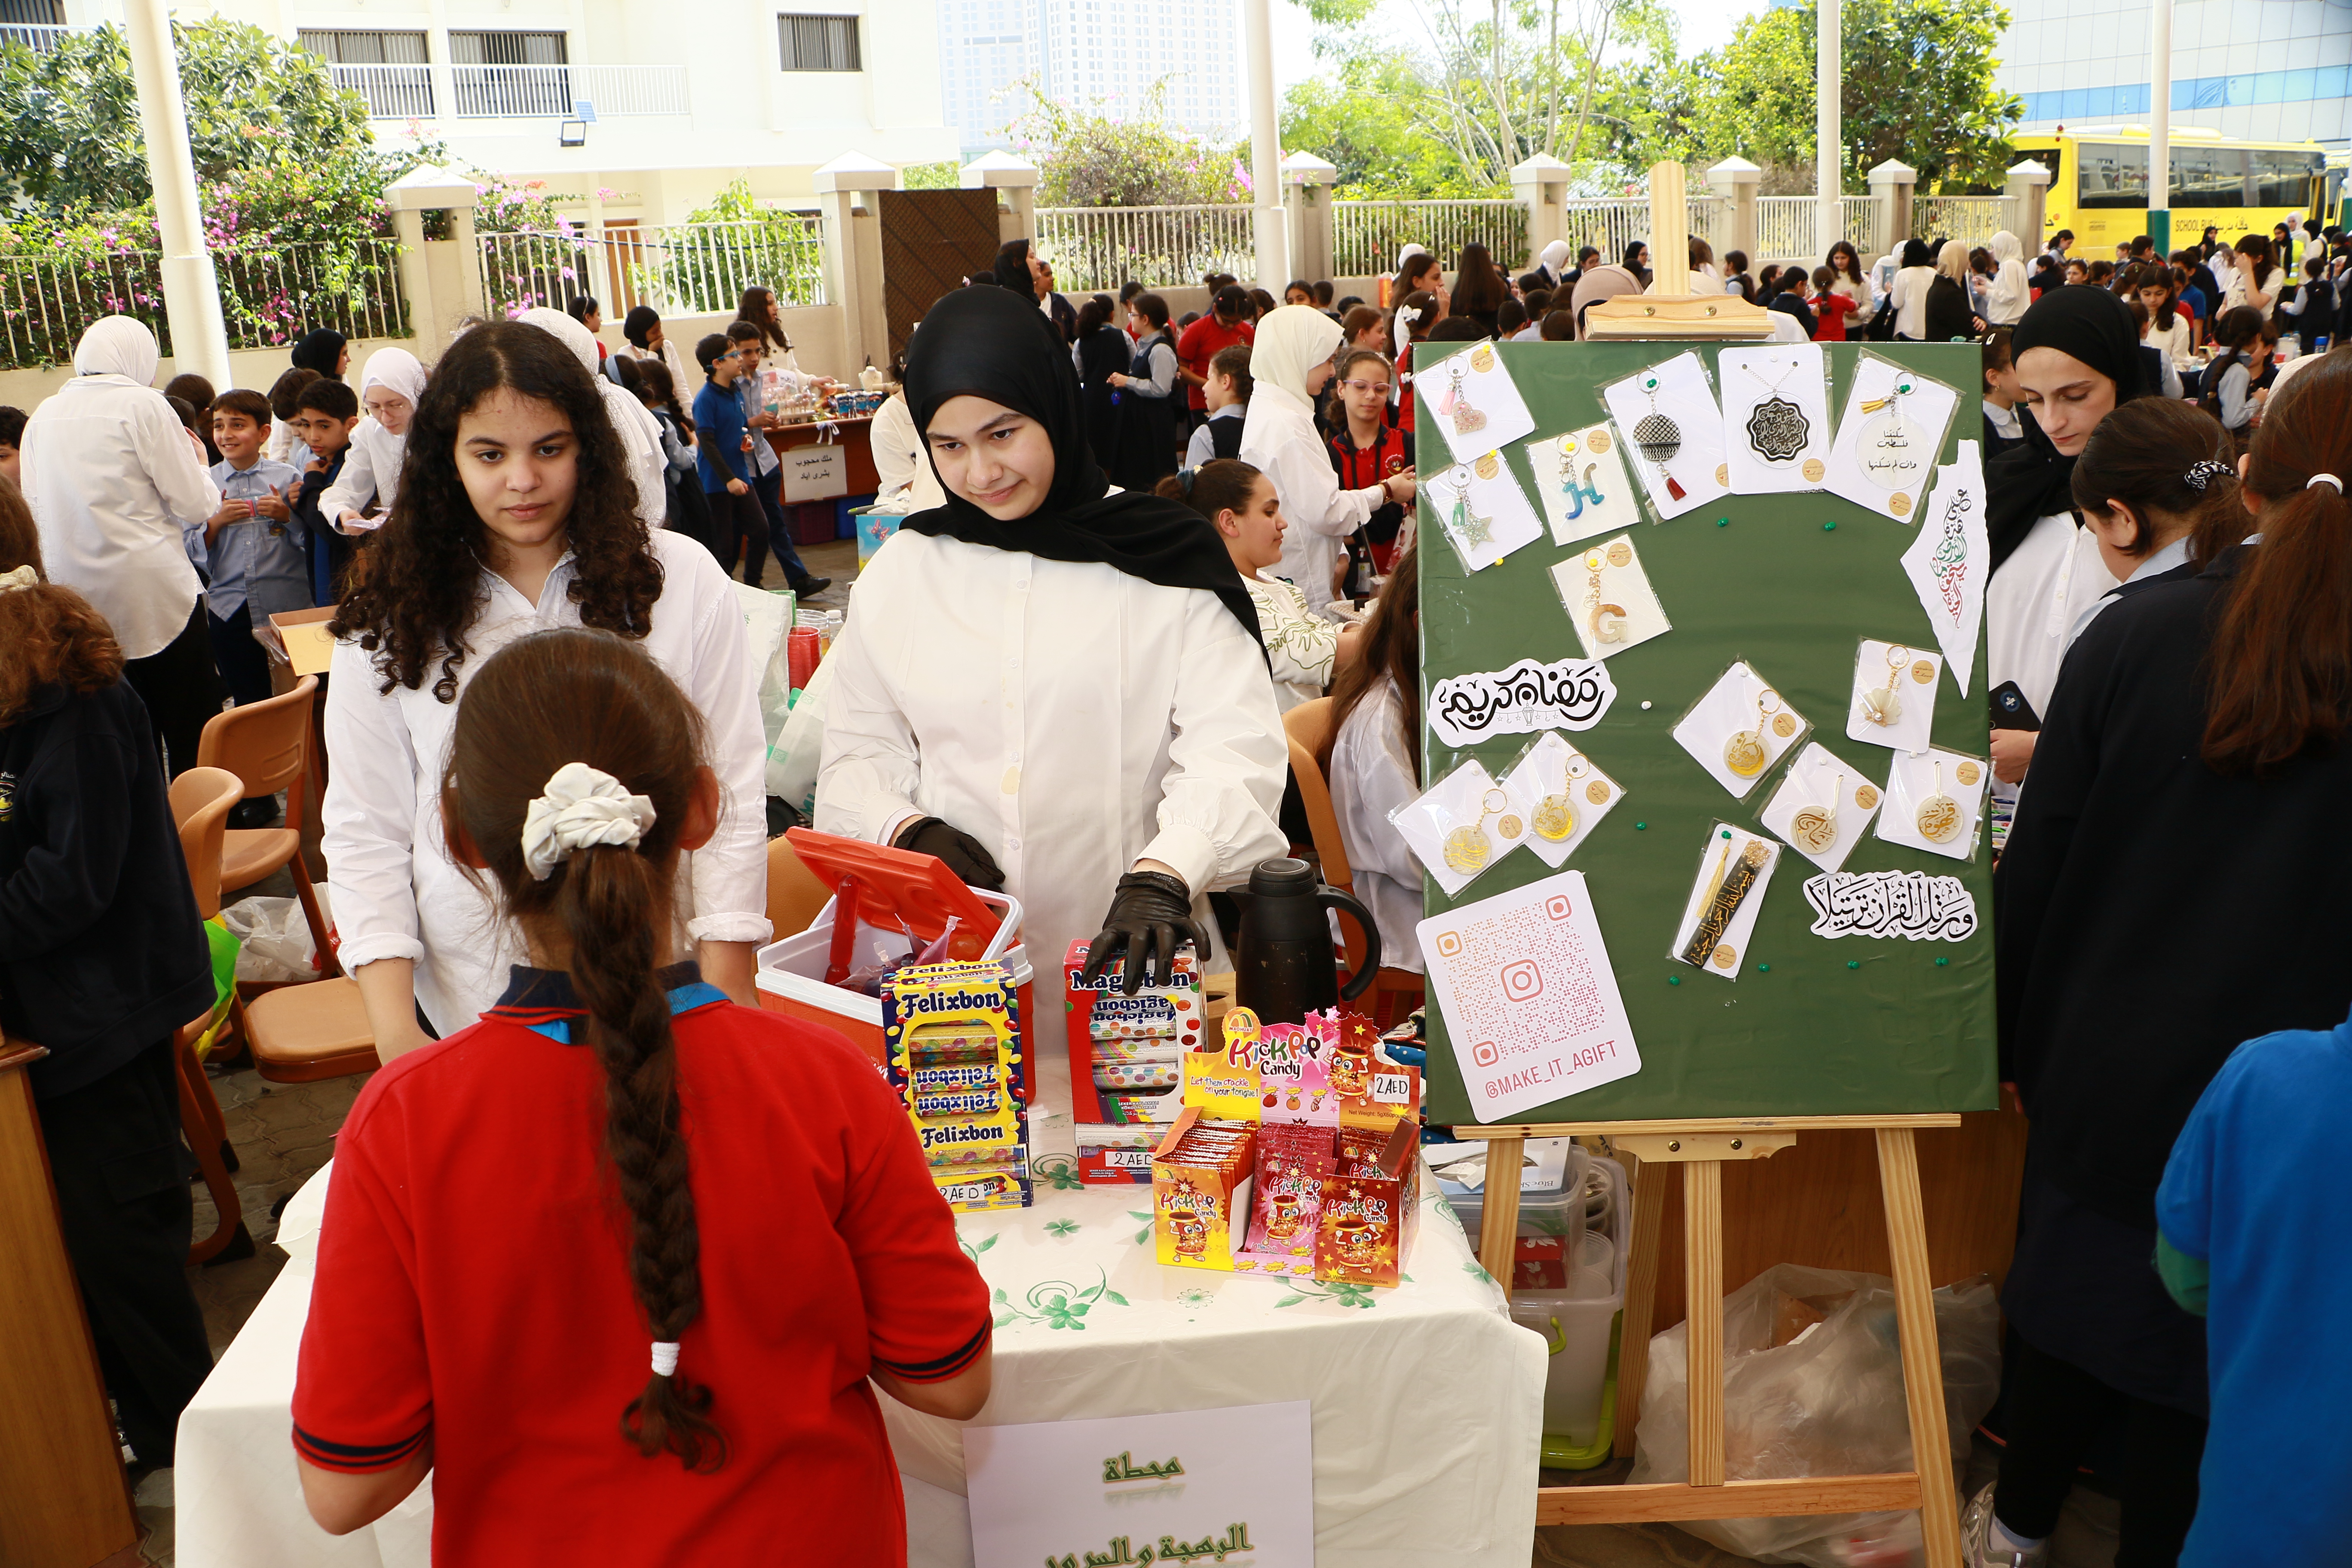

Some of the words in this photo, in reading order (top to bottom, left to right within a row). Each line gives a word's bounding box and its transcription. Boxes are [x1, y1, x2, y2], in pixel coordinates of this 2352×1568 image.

[2175, 218, 2199, 232] SCHOOL
[1877, 438, 1908, 449] فلسطين
[796, 458, 819, 467] محجوب
[903, 962, 998, 975] Felixbon
[927, 971, 983, 983] Felixbon
[1072, 971, 1188, 992] Magbn
[901, 990, 1000, 1019] Felixbon
[1096, 995, 1175, 1012] agicbon
[916, 1064, 996, 1086] Felixbon
[1260, 1060, 1300, 1079] Candy
[1485, 1040, 1617, 1099] @MAKE_IT_AGIFT
[1191, 1076, 1203, 1085] Let
[1204, 1077, 1222, 1087] them
[1223, 1078, 1248, 1087] crackle
[1376, 1077, 1384, 1093] 2
[1384, 1078, 1408, 1094] AED
[1214, 1087, 1230, 1096] your
[1231, 1087, 1258, 1098] tongue!
[917, 1090, 998, 1112] Felixbon
[921, 1124, 1002, 1148] Felixbon
[1114, 1152, 1124, 1165] 2
[1298, 1194, 1320, 1204] Candy
[1194, 1209, 1216, 1219] Candy
[1364, 1214, 1387, 1224] Candy
[1103, 1451, 1185, 1483] محطة
[1159, 1523, 1253, 1562] البهجة
